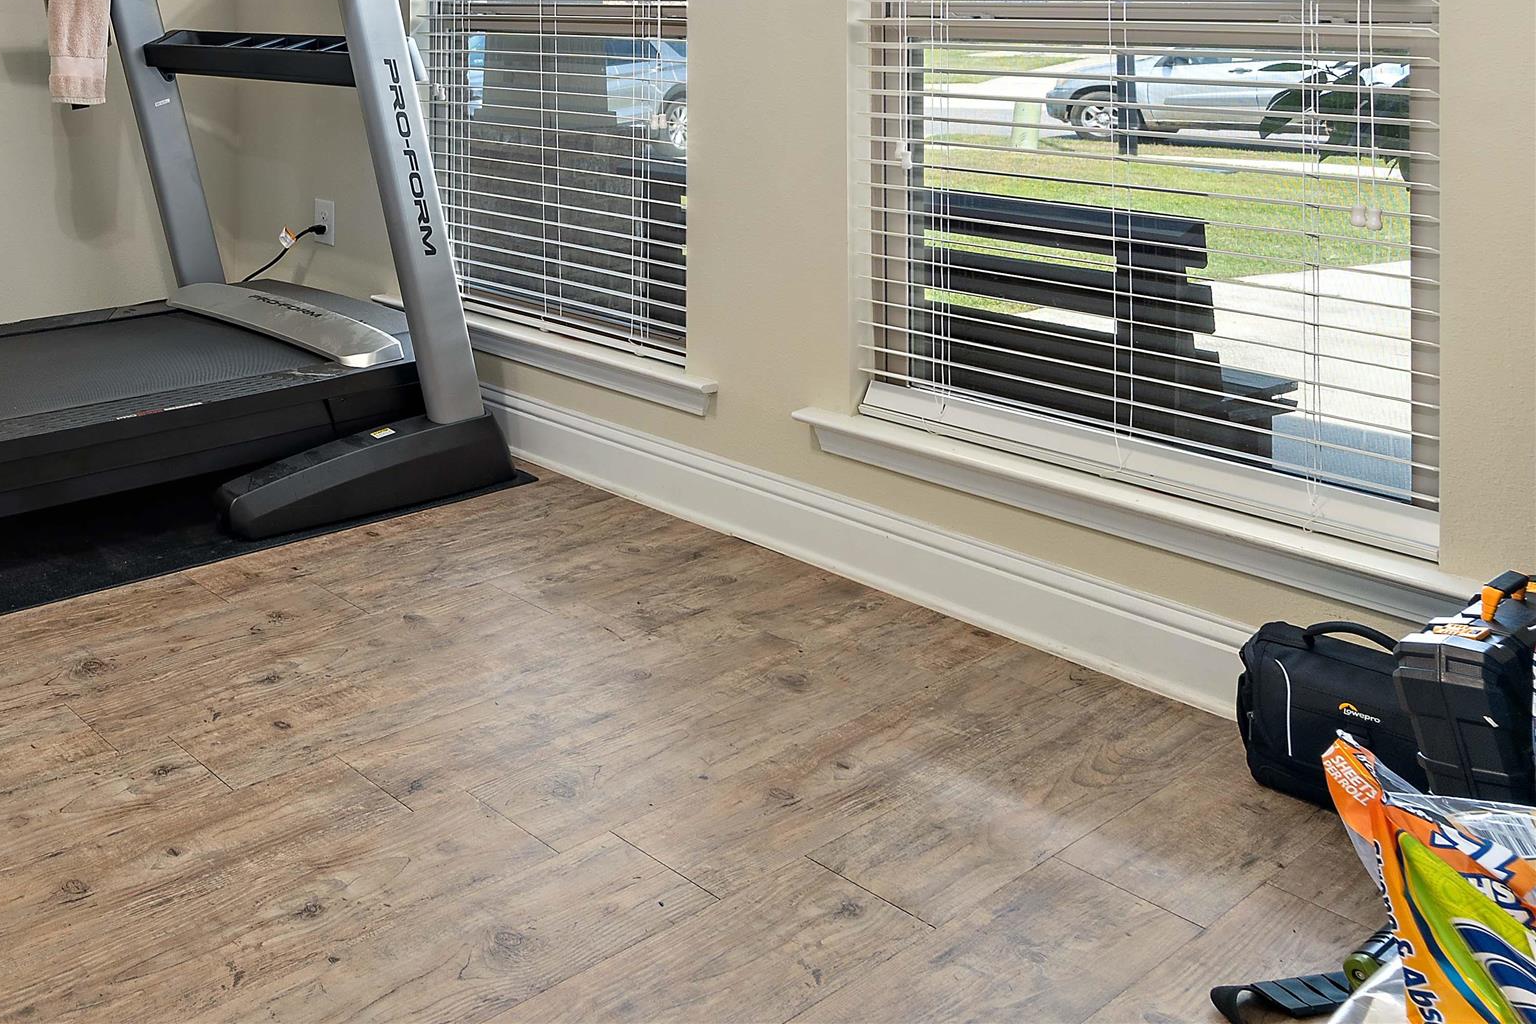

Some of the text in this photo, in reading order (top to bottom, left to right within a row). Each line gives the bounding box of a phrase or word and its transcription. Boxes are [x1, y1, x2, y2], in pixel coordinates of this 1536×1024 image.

[383, 58, 437, 256] PRO-FORM
[1324, 759, 1343, 780] PER
[1339, 777, 1371, 807] ROLL
[1330, 755, 1378, 800] SHEETS
